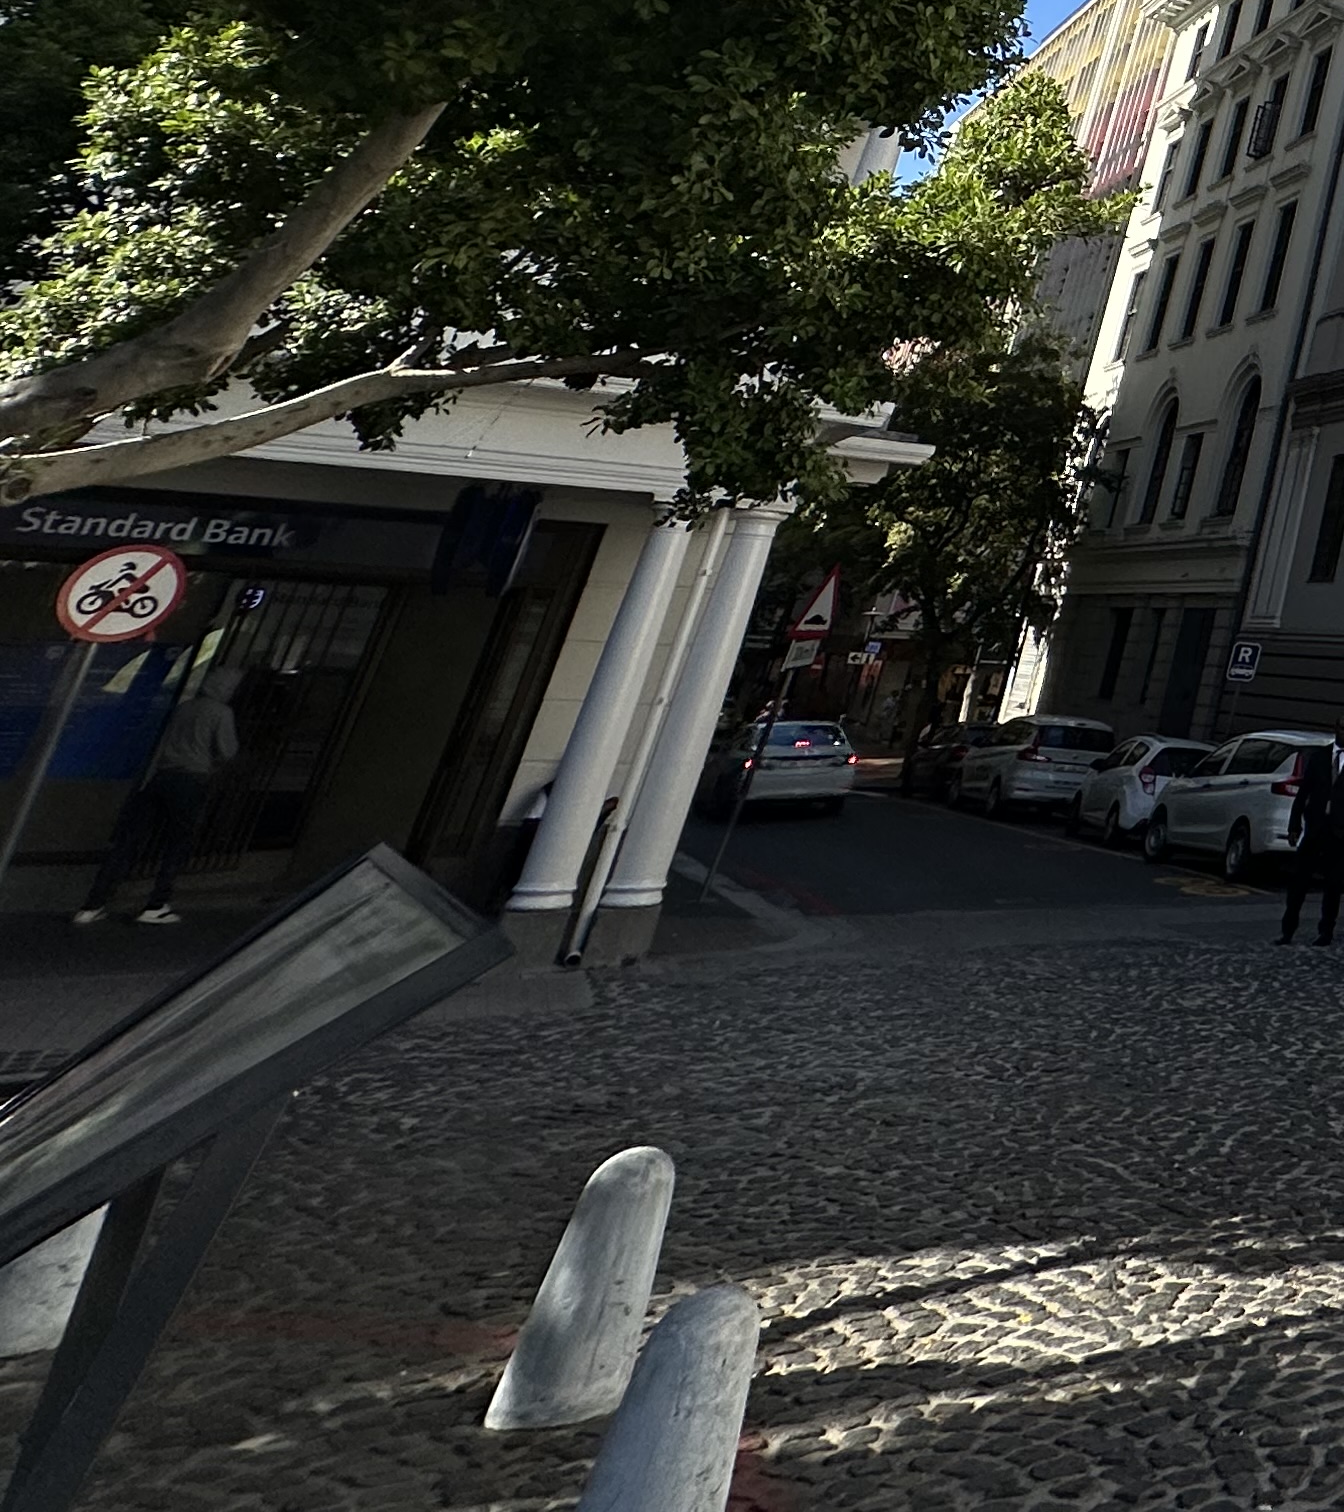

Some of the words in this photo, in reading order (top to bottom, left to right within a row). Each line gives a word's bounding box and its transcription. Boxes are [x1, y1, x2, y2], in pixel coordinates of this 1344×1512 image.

[16, 506, 198, 541] Standard
[201, 518, 296, 547] Bank
[1238, 646, 1253, 663] R
